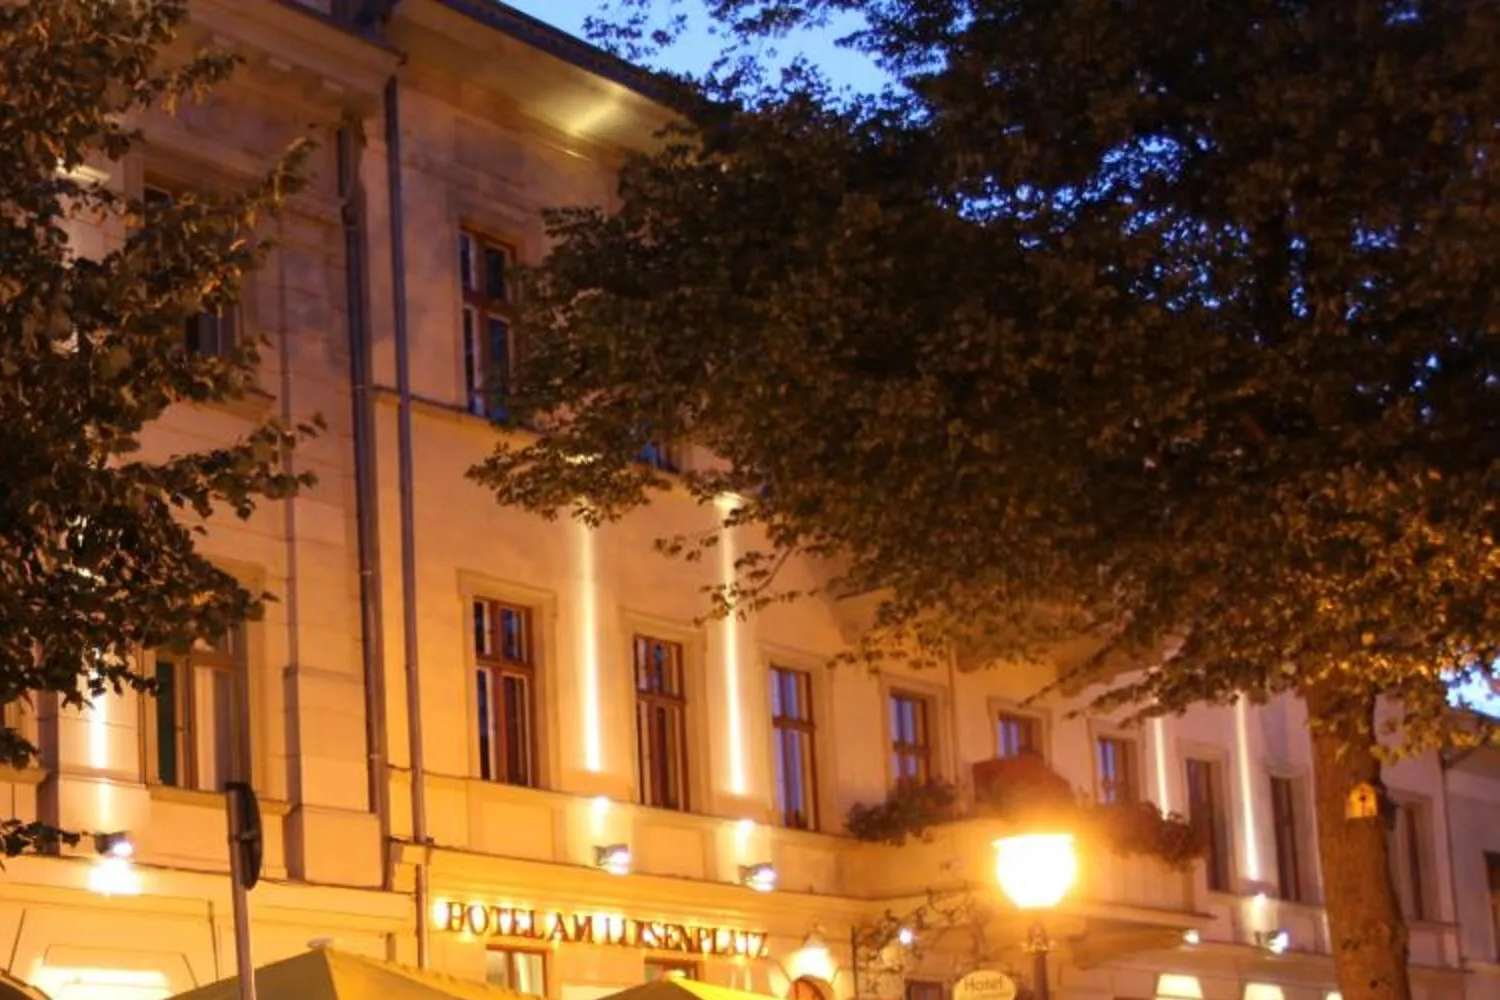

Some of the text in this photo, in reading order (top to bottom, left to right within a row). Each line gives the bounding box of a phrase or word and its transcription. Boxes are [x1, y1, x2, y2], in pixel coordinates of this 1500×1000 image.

[445, 901, 768, 958] HOTEL AM LUISENPLATZ
